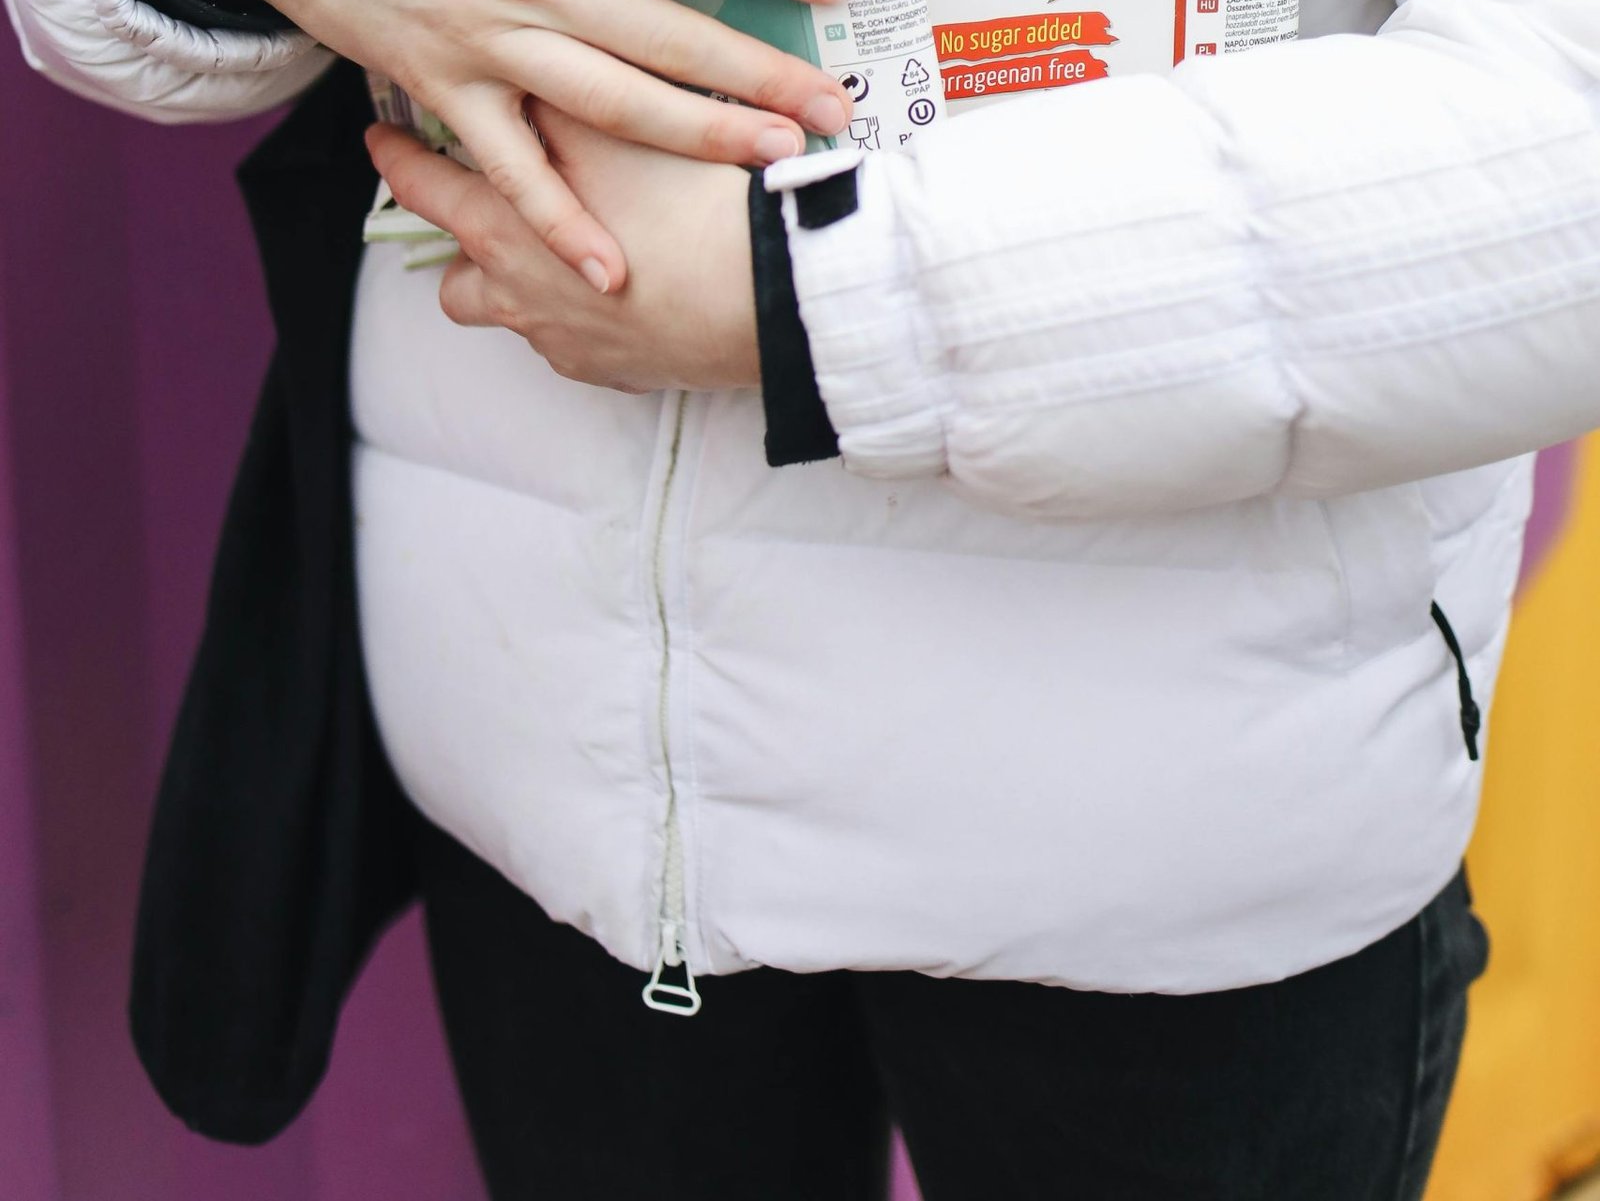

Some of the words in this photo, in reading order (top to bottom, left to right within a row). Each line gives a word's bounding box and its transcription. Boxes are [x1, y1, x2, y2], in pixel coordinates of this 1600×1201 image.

[1200, 0, 1215, 10] HU
[828, 28, 842, 38] SV
[868, 19, 883, 27] OCH
[941, 31, 964, 54] No
[970, 28, 1021, 52] sugar
[1027, 16, 1081, 43] added
[1199, 46, 1211, 54] PL
[1225, 40, 1247, 48] NAPÓJ
[1249, 36, 1279, 45] OWSIANY
[941, 66, 1042, 93] rrageenan
[1049, 58, 1085, 79] free
[906, 84, 930, 96] C/PAP
